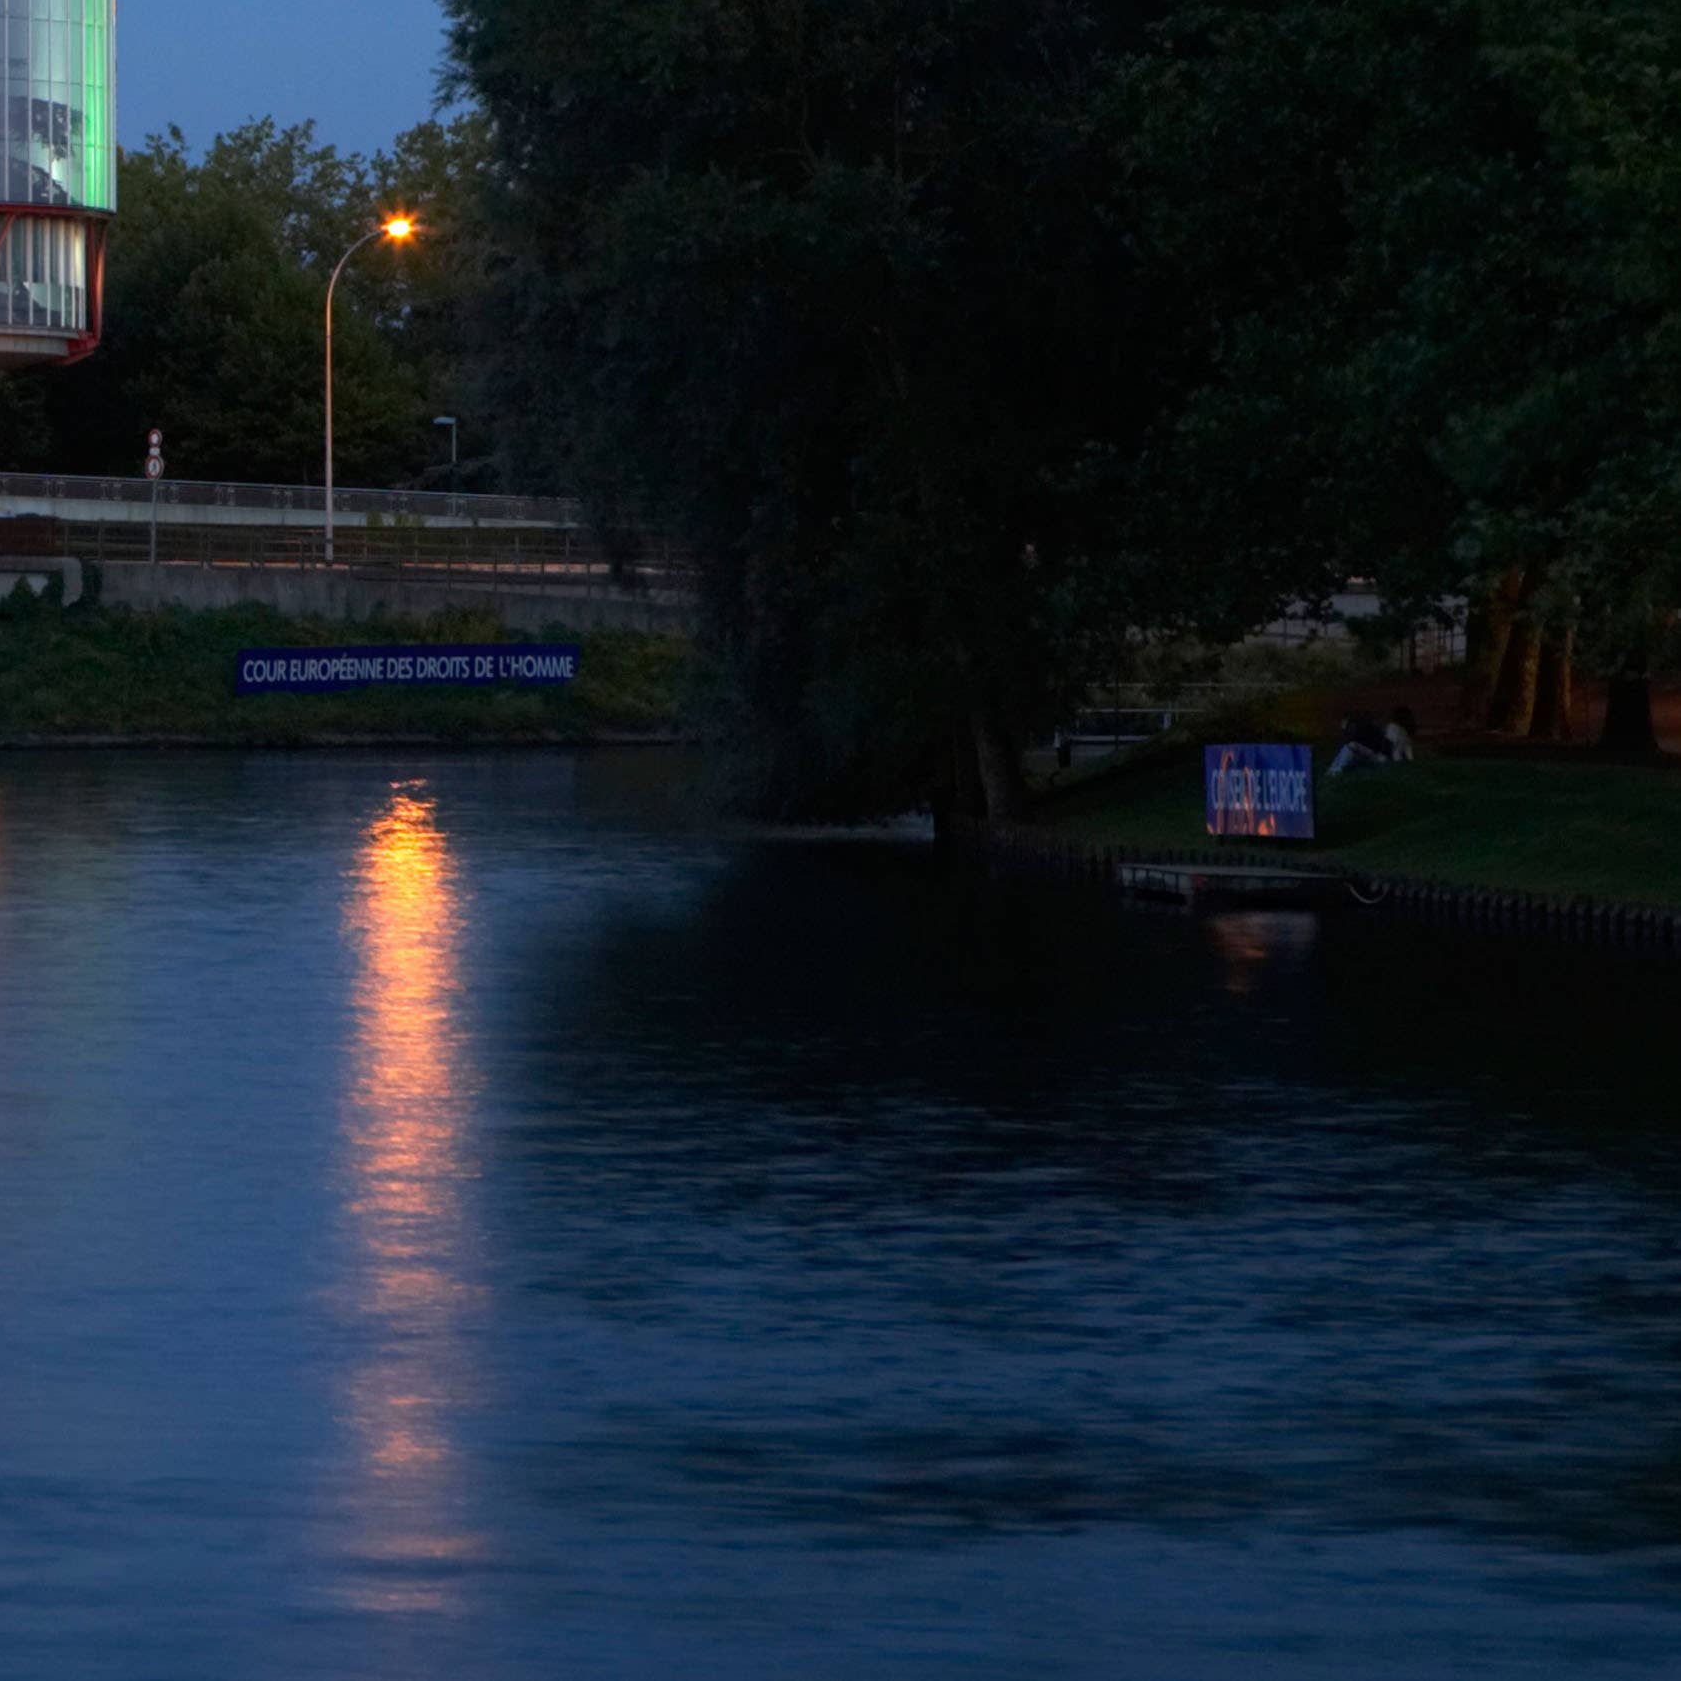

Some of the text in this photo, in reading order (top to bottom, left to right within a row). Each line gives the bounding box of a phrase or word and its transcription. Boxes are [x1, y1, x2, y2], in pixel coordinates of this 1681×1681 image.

[243, 653, 574, 683] COUR EUROPÉENNE DES DROITS DE L'HOMME
